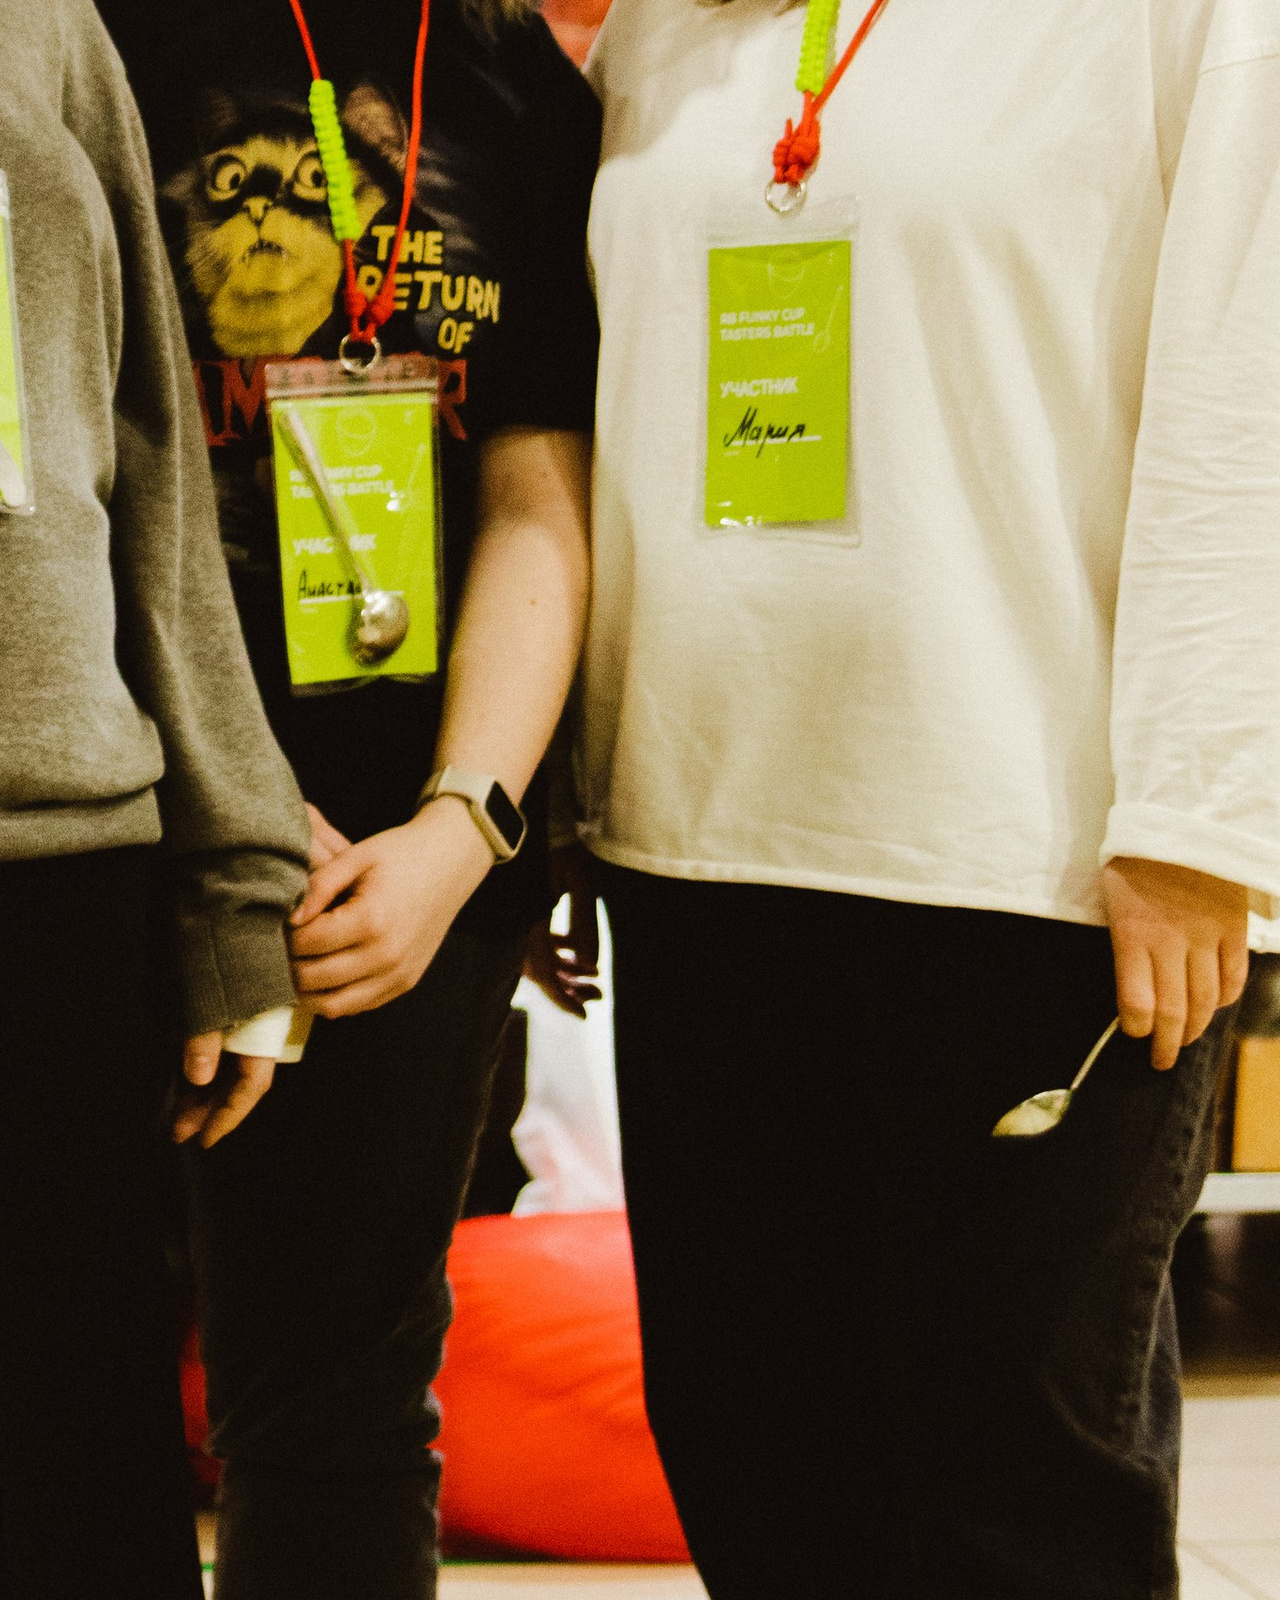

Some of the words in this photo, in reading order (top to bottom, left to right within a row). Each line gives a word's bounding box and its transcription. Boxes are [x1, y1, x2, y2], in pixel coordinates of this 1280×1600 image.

[371, 224, 443, 265] THE
[357, 264, 500, 324] RETURN
[738, 310, 780, 323] FUNKY
[781, 307, 806, 321] CUP
[437, 317, 474, 354] OF
[720, 325, 772, 341] TASTERS
[773, 323, 815, 338] BATTLE
[720, 376, 799, 399] УЧАСТНИК
[723, 406, 806, 458] Мария
[355, 465, 383, 478] CUP
[347, 480, 394, 495] BATTLE
